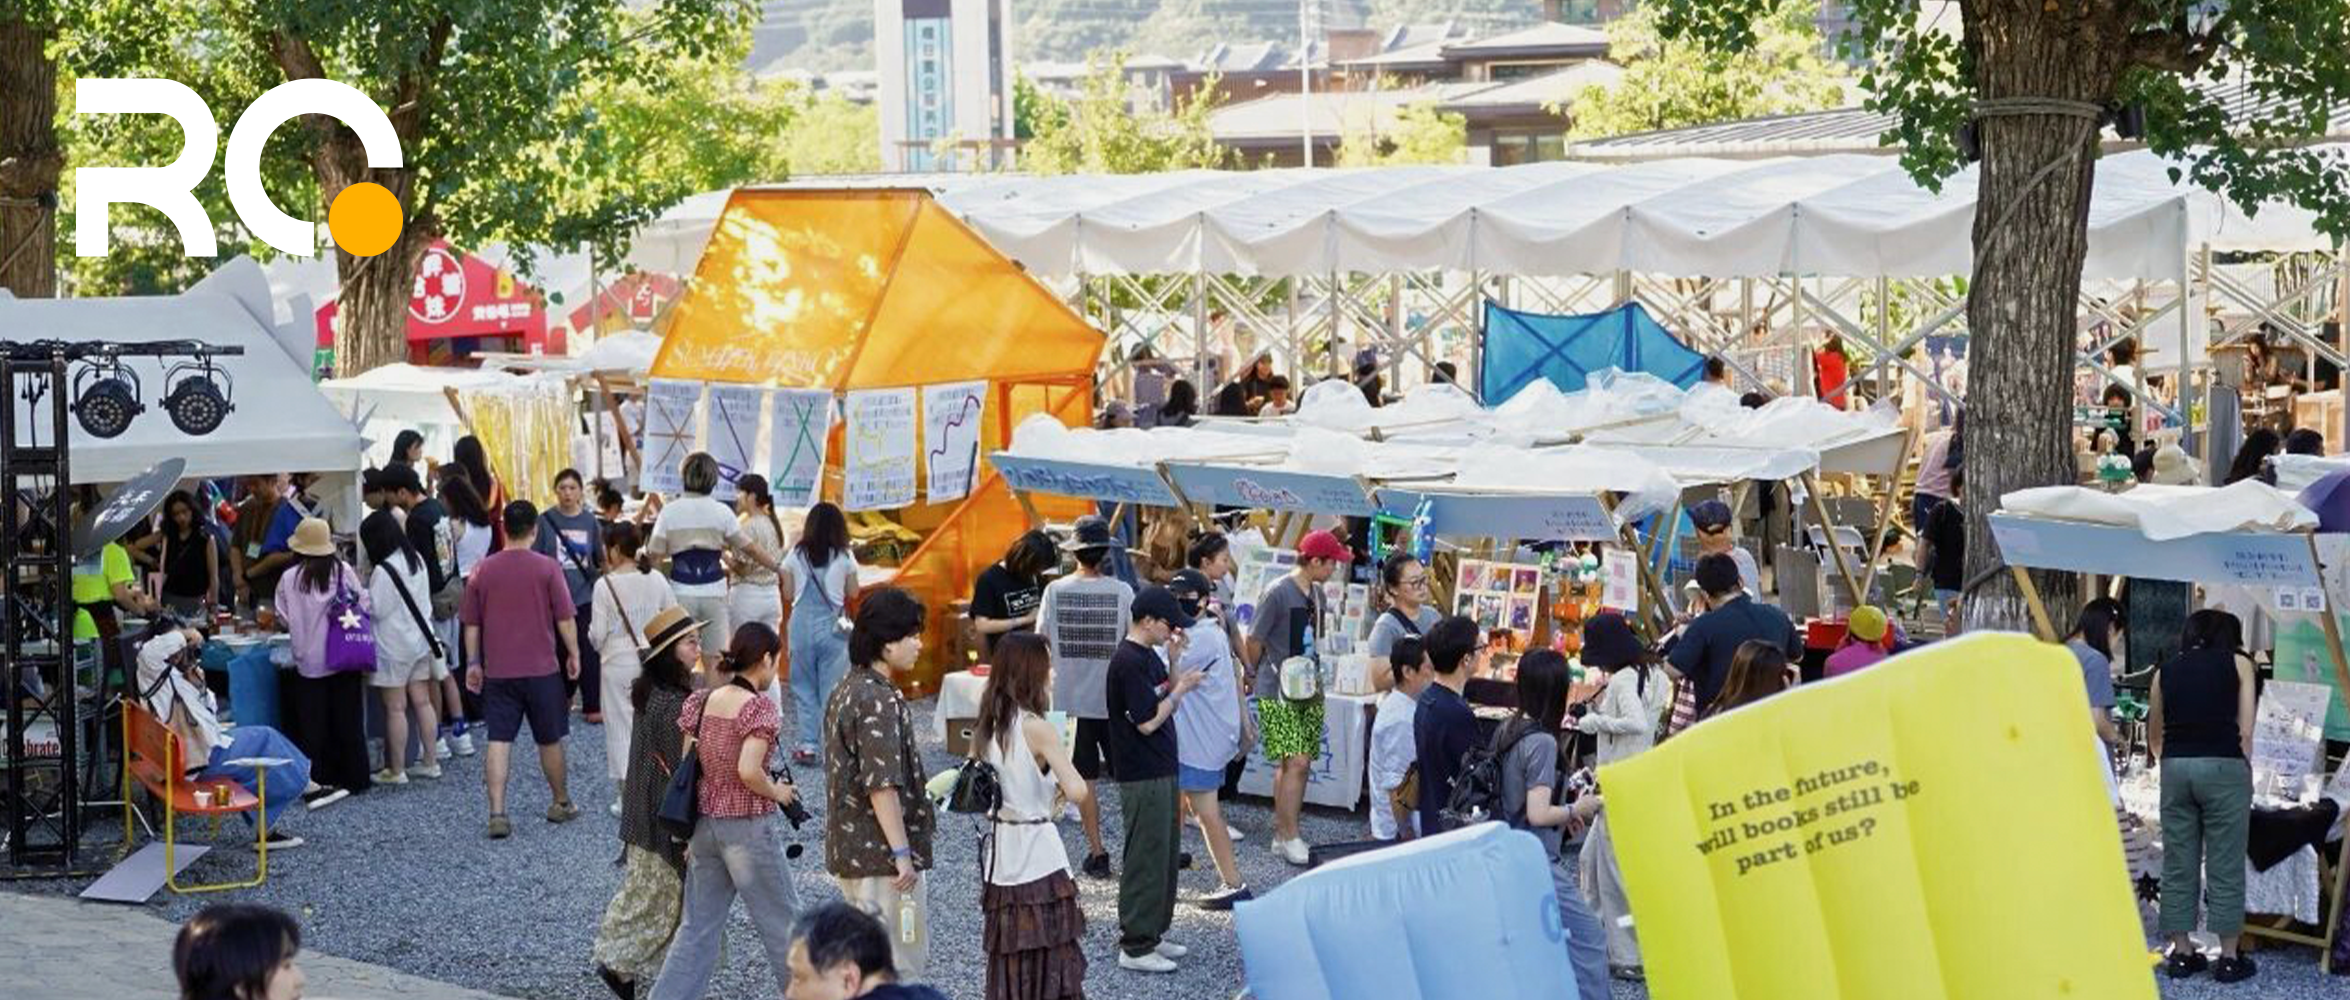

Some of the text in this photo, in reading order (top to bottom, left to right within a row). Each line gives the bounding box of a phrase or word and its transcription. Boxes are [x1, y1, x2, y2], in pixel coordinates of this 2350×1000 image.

[1696, 780, 1921, 856] will books still be
[1708, 760, 1889, 821] In the future,
[1736, 817, 1877, 876] part of us?
